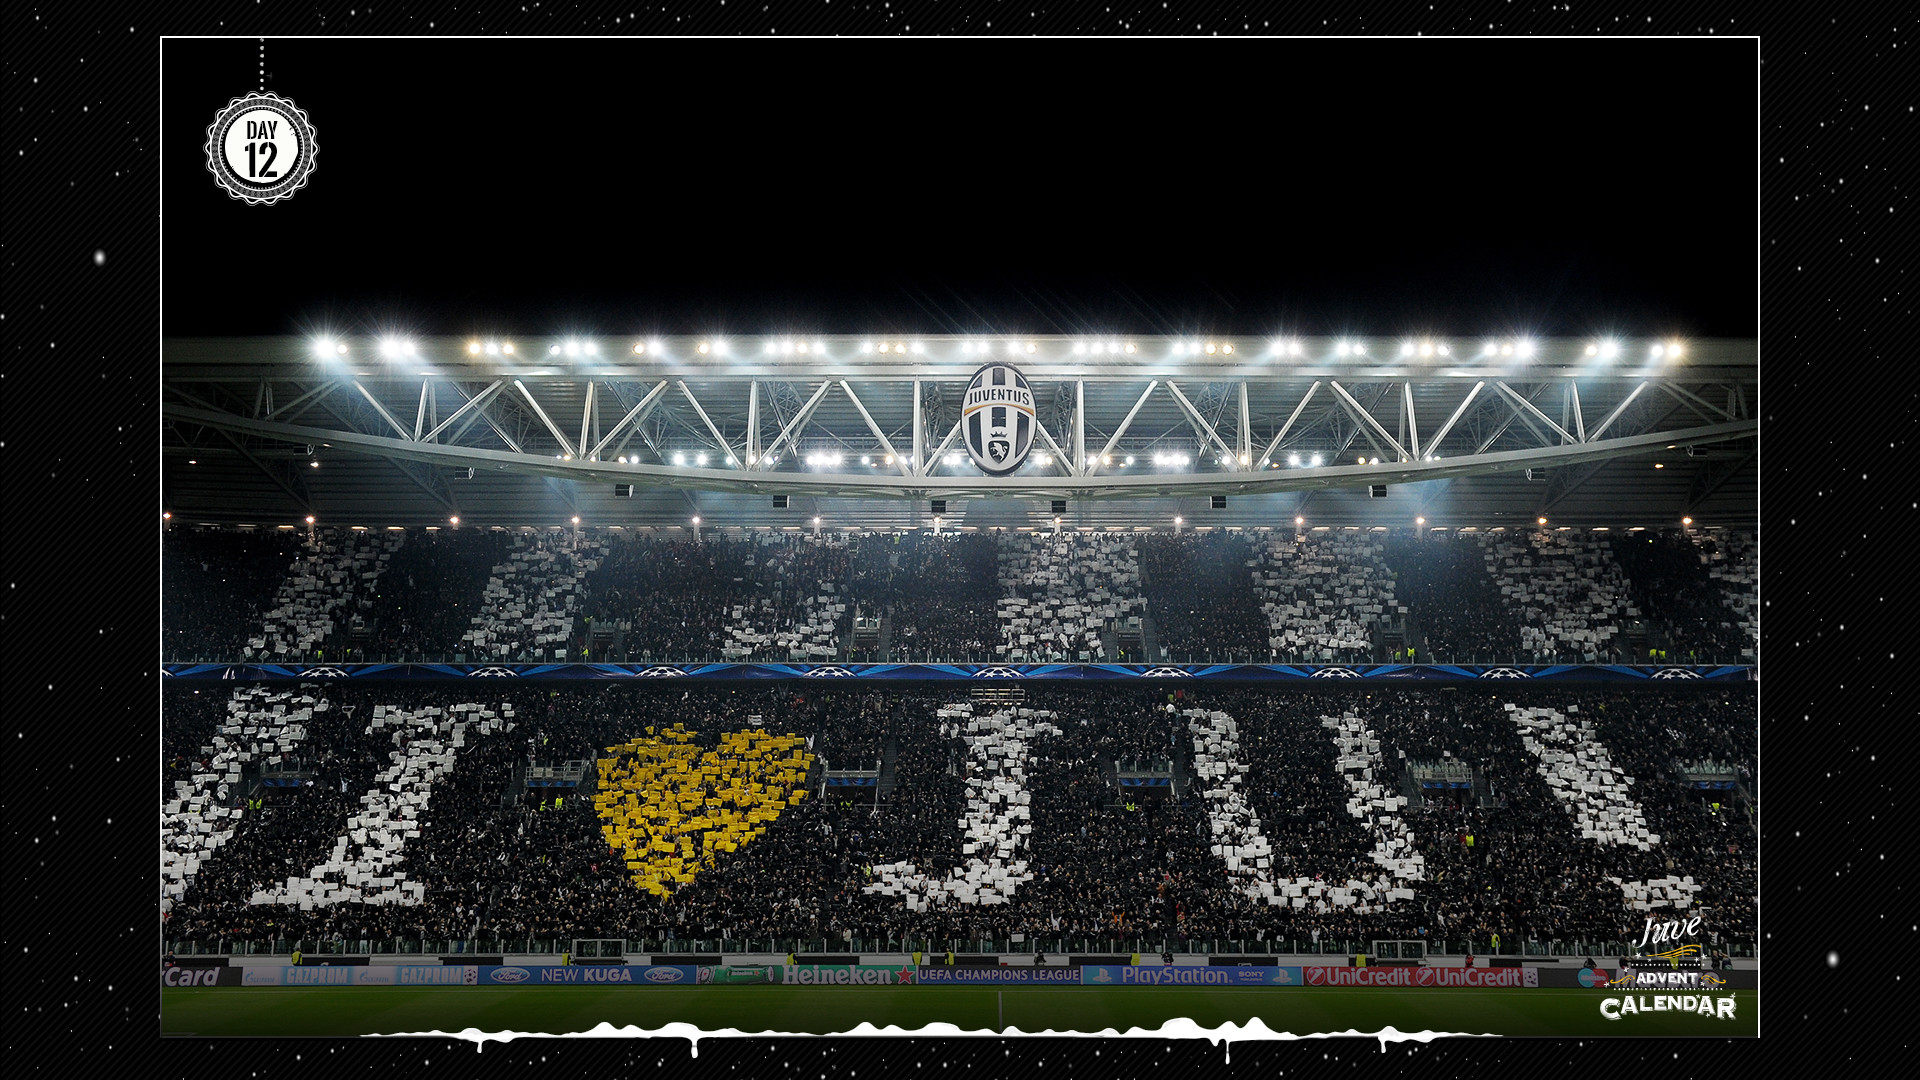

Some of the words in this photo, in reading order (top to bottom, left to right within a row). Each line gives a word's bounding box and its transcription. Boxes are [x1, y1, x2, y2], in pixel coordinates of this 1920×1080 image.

[968, 388, 1030, 406] JUVENTUS
[286, 967, 348, 984] GAZPROM
[401, 967, 462, 984] GAZPROM
[496, 968, 523, 981] Ford
[541, 968, 579, 982] NEW
[583, 968, 632, 982] KUGA
[649, 968, 677, 981] Ford
[781, 965, 893, 985] Heineken
[919, 969, 952, 981] UEFA
[955, 969, 1028, 981] CHAMPIONS
[1032, 969, 1079, 981] LEAGUE
[1238, 970, 1265, 978] SONY
[1326, 967, 1412, 986] UniCredit
[1436, 967, 1521, 986] UniCredit
